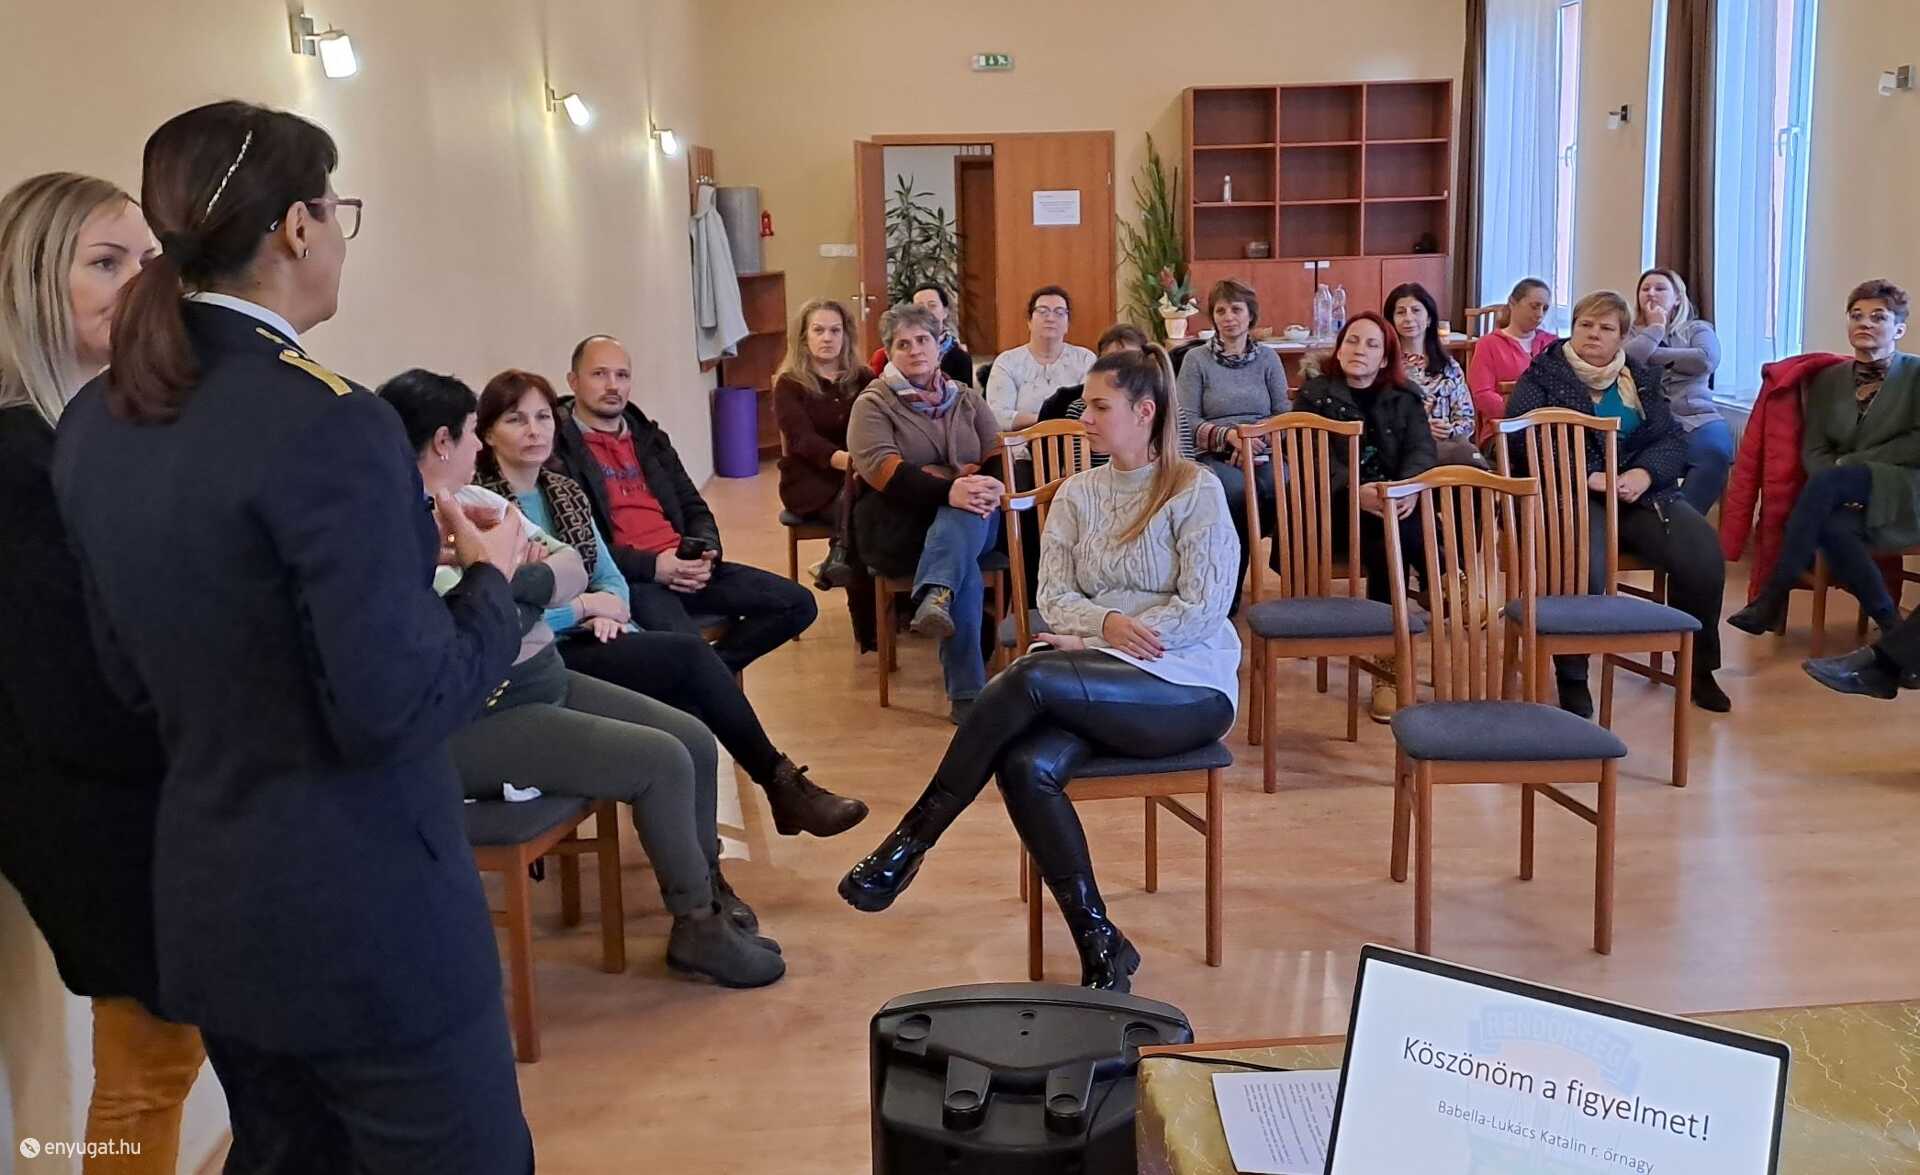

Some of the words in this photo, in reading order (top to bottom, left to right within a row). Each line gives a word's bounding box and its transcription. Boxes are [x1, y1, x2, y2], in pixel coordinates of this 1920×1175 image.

[1403, 1036, 1533, 1094] Köszönöm
[1542, 1079, 1557, 1100] a
[1566, 1079, 1710, 1142] figyelmet!
[1438, 1099, 1536, 1140] Babella-Lukács
[1540, 1128, 1587, 1157] Katalin
[1591, 1147, 1599, 1158] r.
